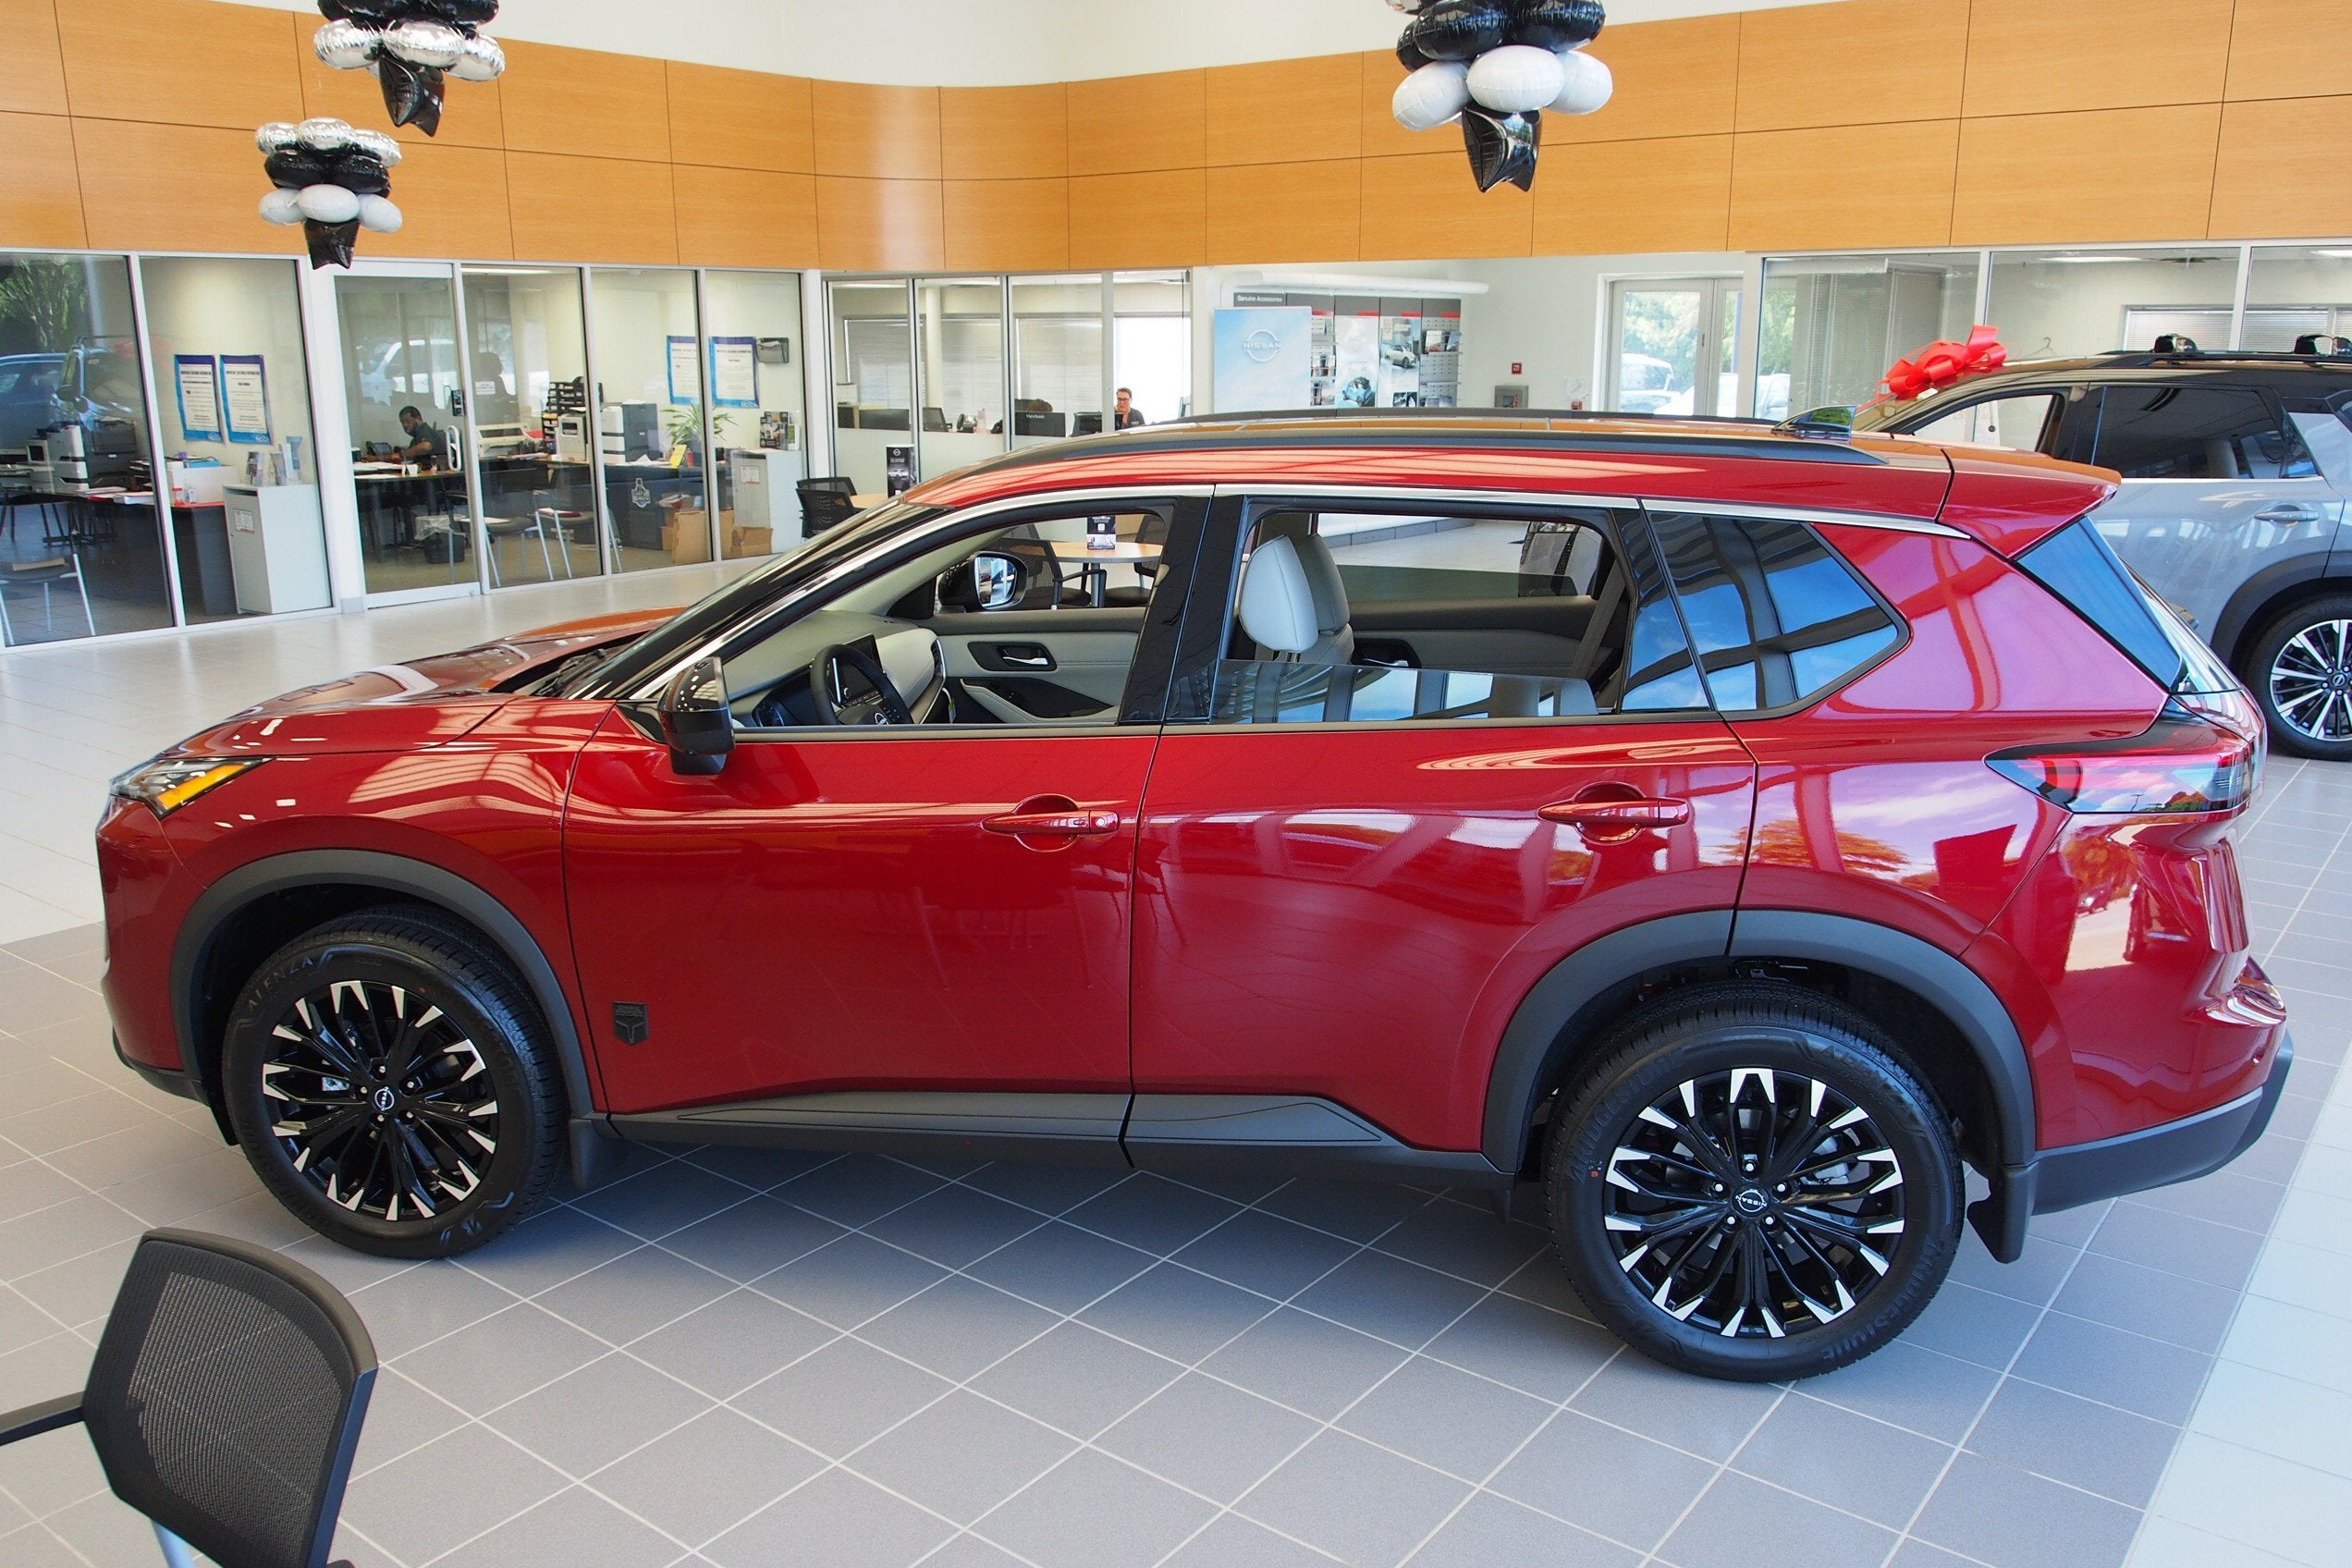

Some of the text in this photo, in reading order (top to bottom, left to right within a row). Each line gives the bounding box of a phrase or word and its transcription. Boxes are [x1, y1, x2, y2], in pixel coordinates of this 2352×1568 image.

[1237, 294, 1283, 303] Genuine Accessories
[1734, 1194, 1768, 1207] NISSAN
